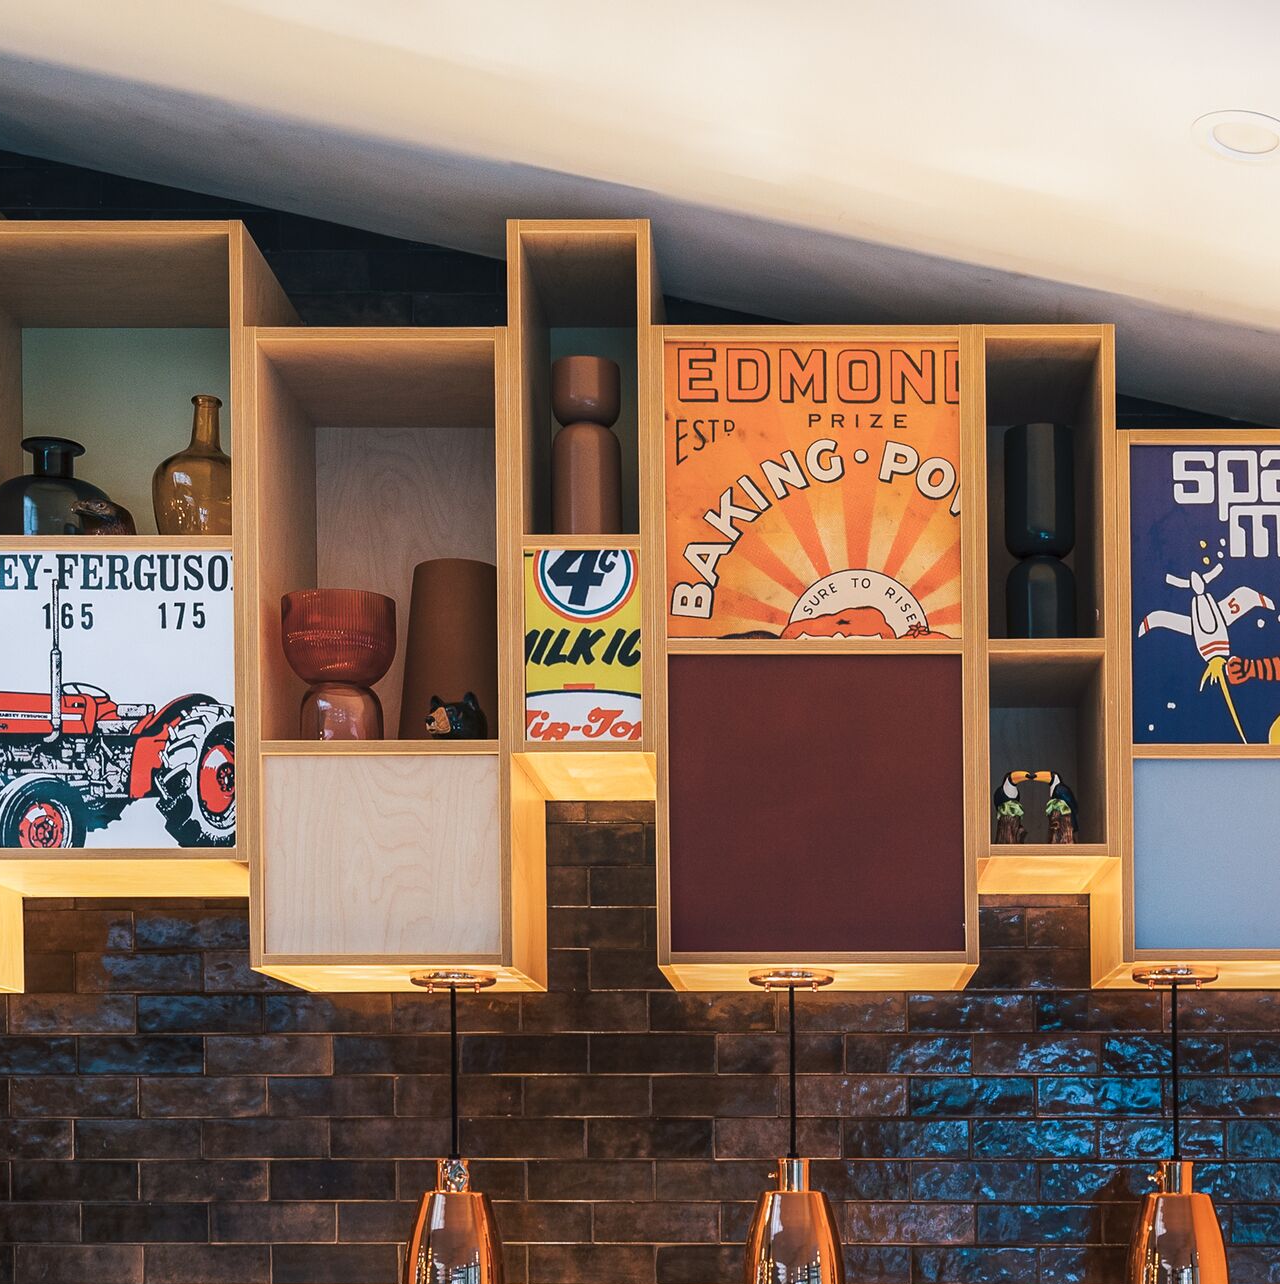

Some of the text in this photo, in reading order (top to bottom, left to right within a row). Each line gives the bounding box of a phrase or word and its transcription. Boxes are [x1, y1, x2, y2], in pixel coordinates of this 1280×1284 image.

[808, 413, 908, 429] PRIZE
[671, 438, 960, 619] BAKING PO
[803, 577, 918, 623] SURE TO RISE
[1227, 597, 1241, 616] 5
[42, 602, 94, 630] 165
[158, 601, 206, 630] 175
